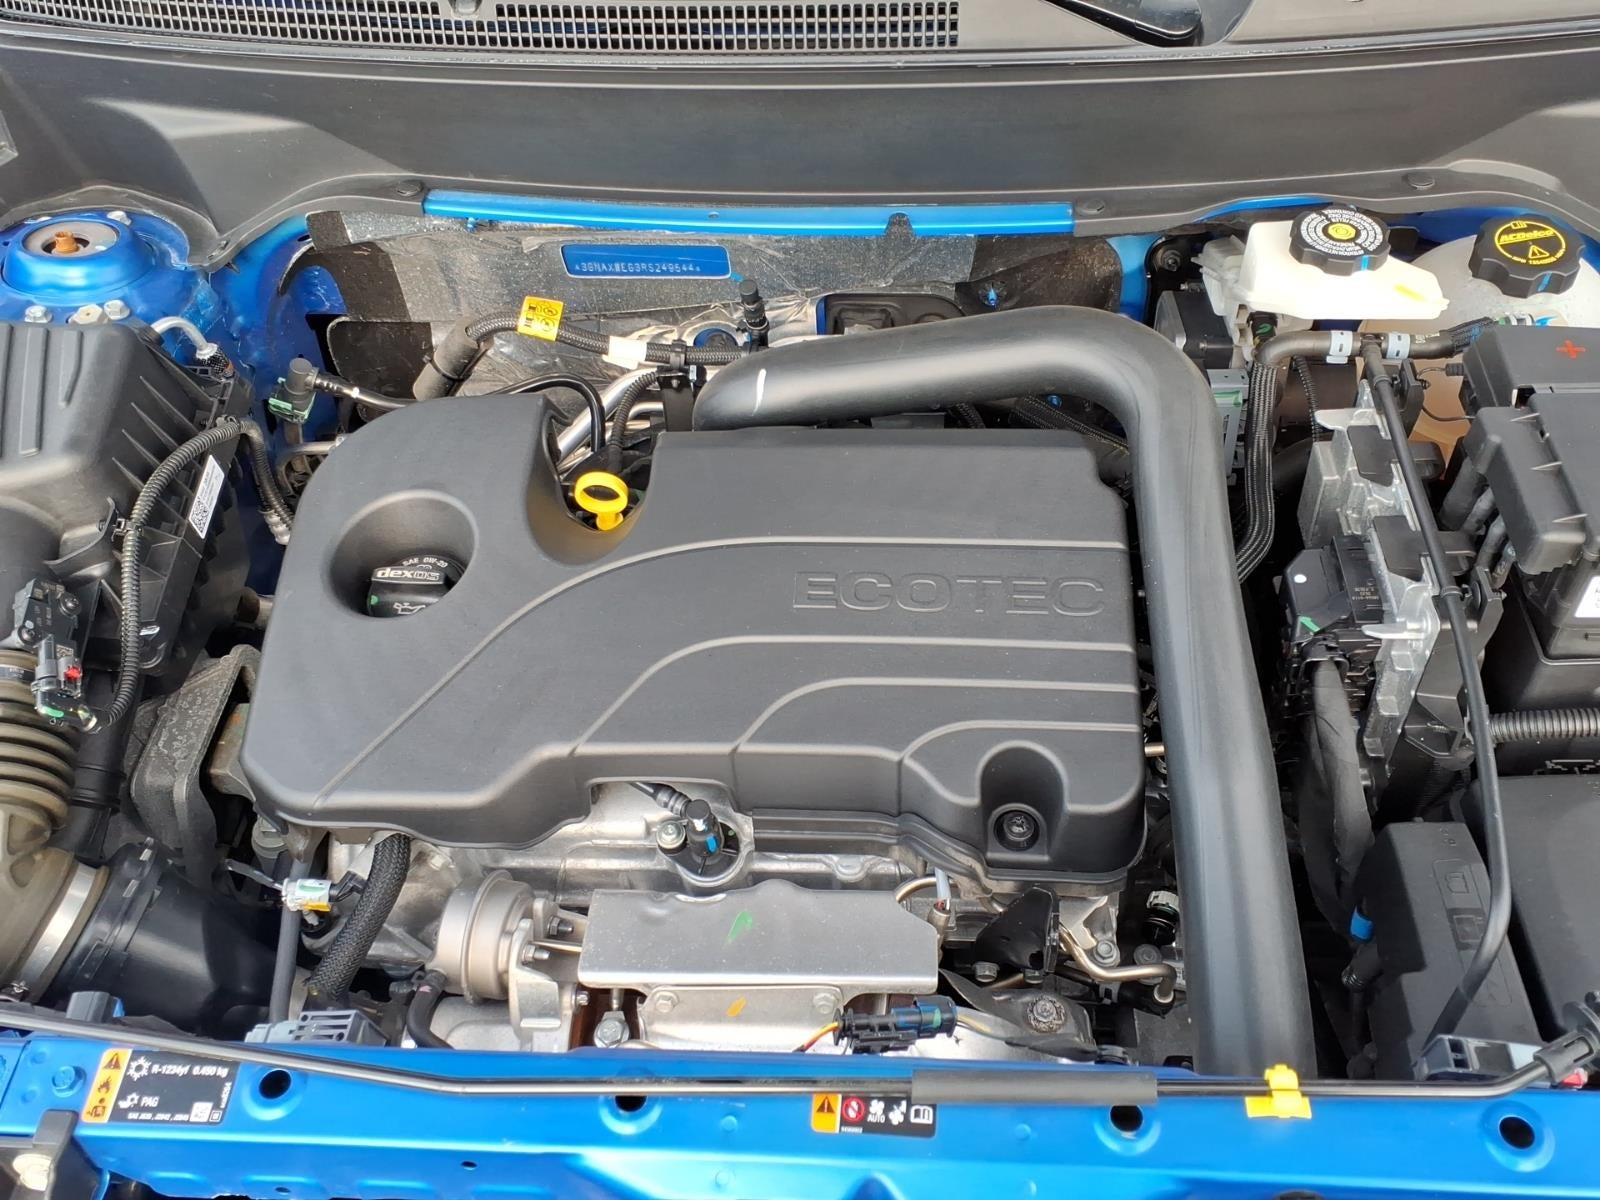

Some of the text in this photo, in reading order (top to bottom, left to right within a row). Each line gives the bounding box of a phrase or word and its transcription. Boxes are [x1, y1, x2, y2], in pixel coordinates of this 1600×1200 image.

[402, 557, 420, 566] SAE
[376, 567, 440, 581] dexos
[793, 571, 1104, 616] ECOTEC
[151, 1064, 192, 1077] R-1234yf
[216, 1066, 230, 1078] kg
[141, 1096, 160, 1107] PAG
[867, 1114, 886, 1124] AUTO
